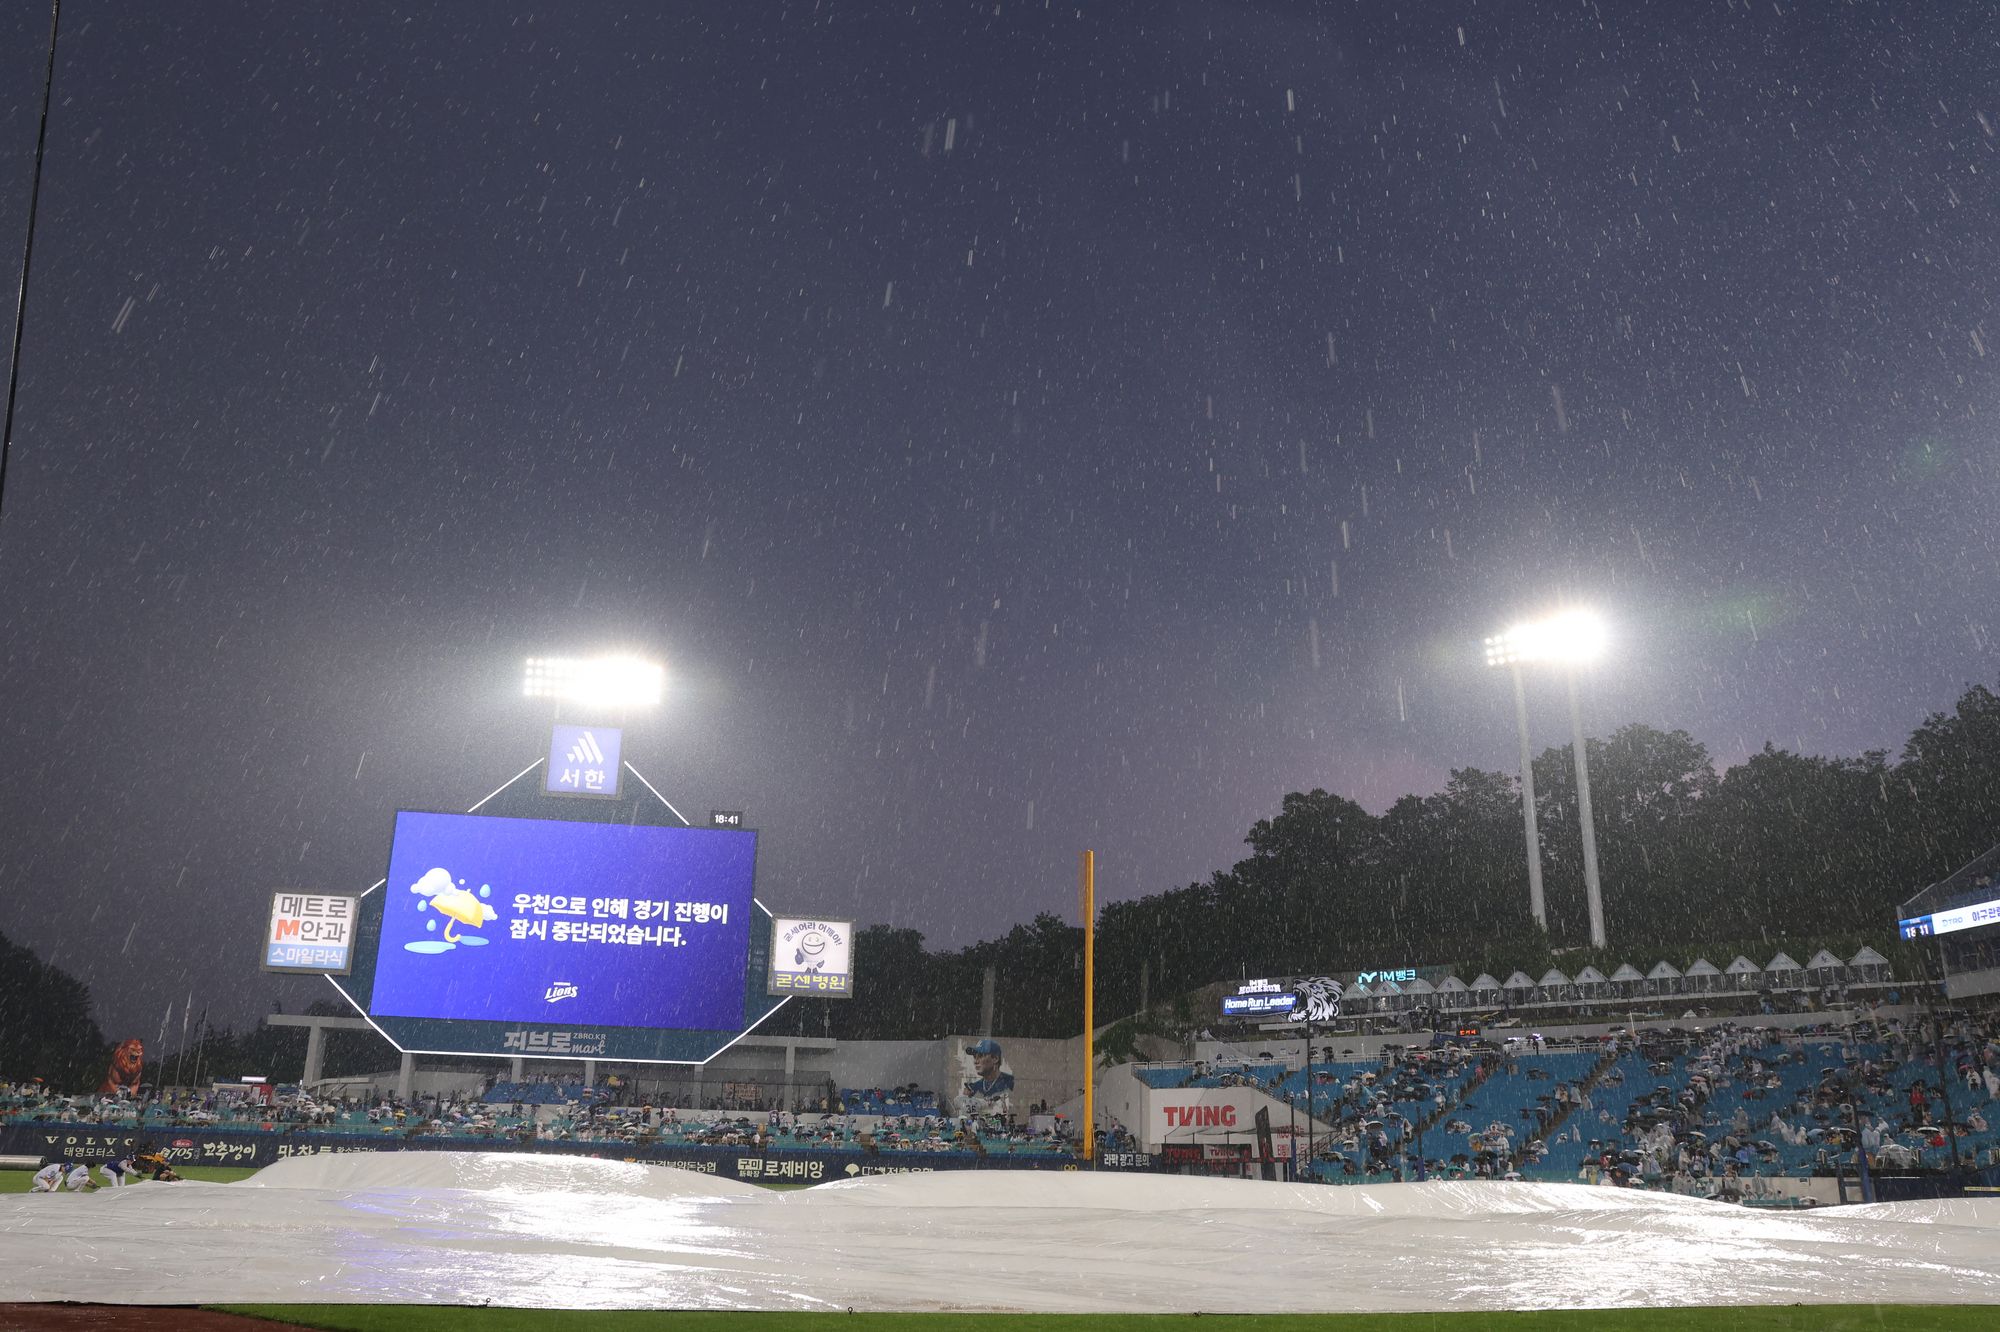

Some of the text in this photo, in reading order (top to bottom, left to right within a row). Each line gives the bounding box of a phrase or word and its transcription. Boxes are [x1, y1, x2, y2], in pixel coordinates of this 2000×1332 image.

[560, 768, 605, 790] 서한
[714, 814, 739, 825] 18:41
[280, 896, 347, 918] 메트로
[512, 893, 729, 924] 우천으로 인해 경기 진행이
[275, 919, 346, 943] M안과
[509, 919, 687, 947] 잠시 중단되었습니다.
[271, 947, 343, 965] 스마일라식
[776, 974, 845, 990] 굳센병원
[1380, 969, 1416, 982] iM뱅크
[544, 986, 578, 1000] Lions
[1225, 996, 1296, 1009] Home Run Leader
[503, 1031, 572, 1053] 지브로
[573, 1032, 606, 1040] ZBRO.KR
[572, 1040, 606, 1055] mart
[1163, 1105, 1236, 1127] TVING
[63, 1147, 116, 1158] 태영모터스
[170, 1147, 193, 1159] 705
[1120, 1153, 1133, 1167] 광고
[764, 1160, 824, 1179] 로제비앙
